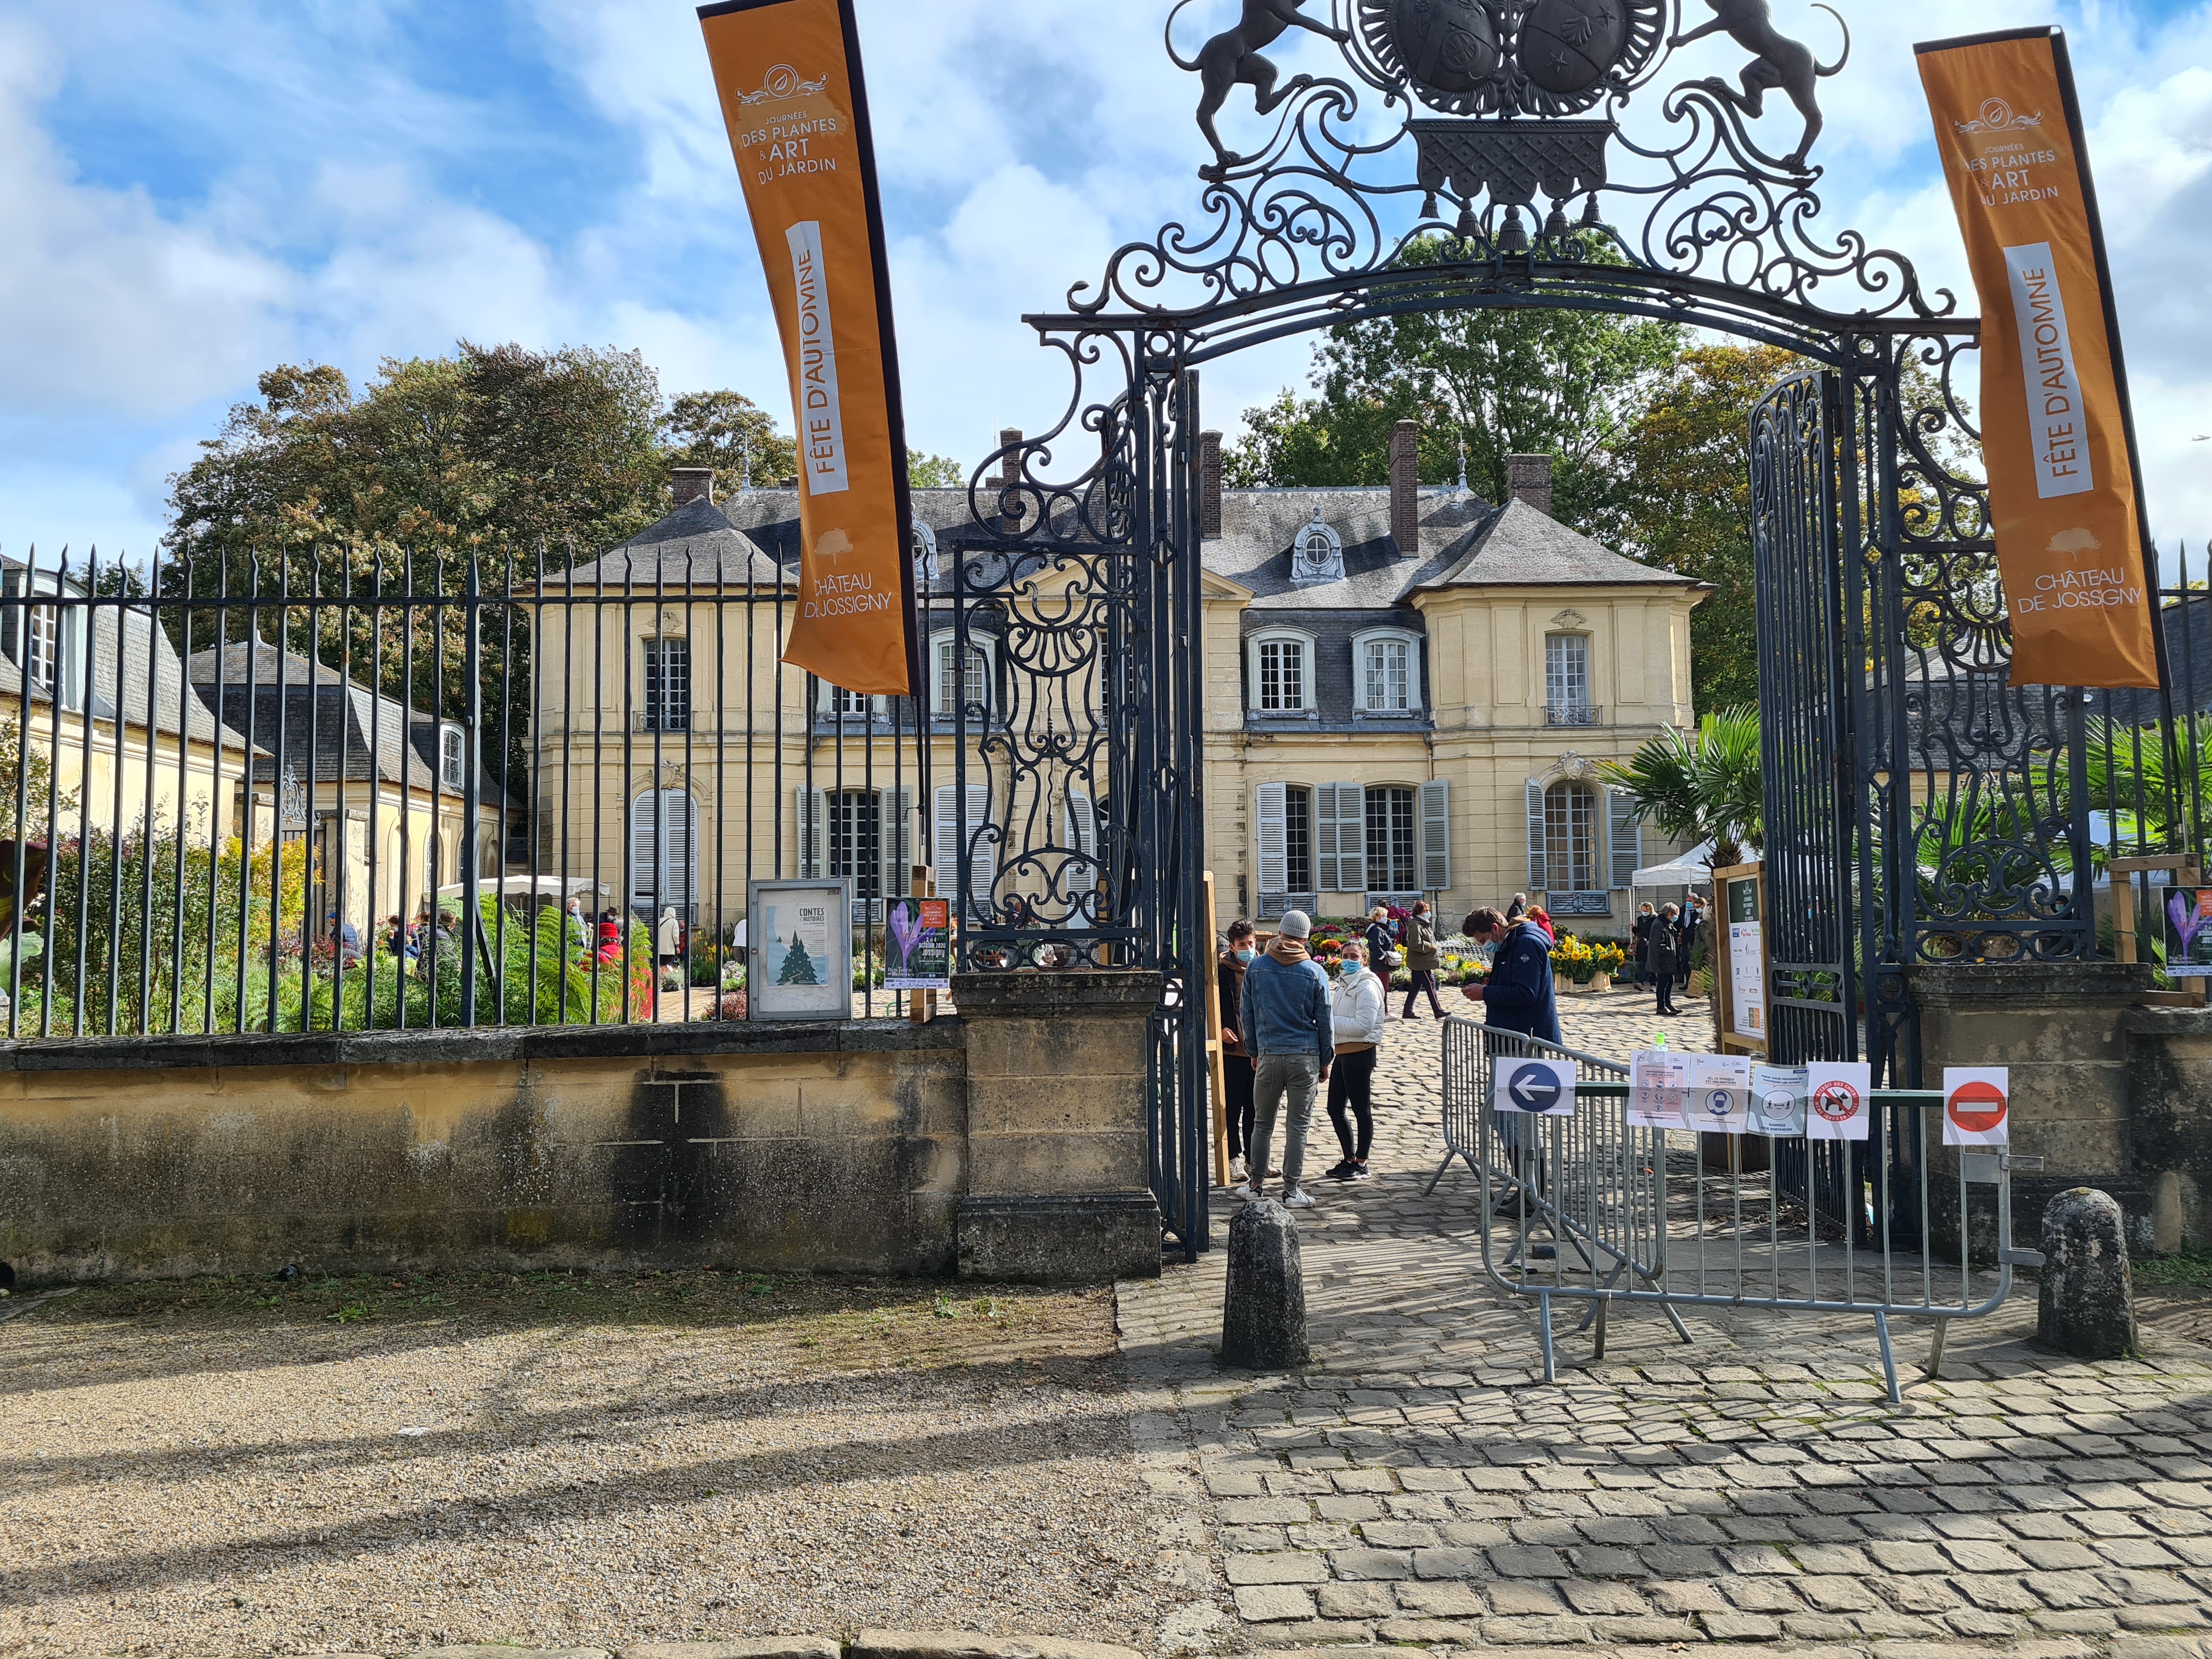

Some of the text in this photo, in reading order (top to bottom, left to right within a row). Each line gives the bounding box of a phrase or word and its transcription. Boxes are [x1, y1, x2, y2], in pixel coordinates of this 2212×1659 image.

[765, 111, 807, 125] JOURNÉES
[741, 118, 837, 148] DES PLANTES
[759, 138, 809, 162] & ART
[1984, 142, 2024, 154] JOURNÉES
[758, 157, 836, 185] DU JARDIN
[1964, 149, 2056, 172] ES PLANTES
[1980, 169, 2029, 190] & ART
[2002, 185, 2059, 205] JARDIN
[799, 249, 835, 475] FÊTE D'AUTOMNE
[2022, 268, 2078, 478] FÊTE D'AUTOMNE
[2035, 567, 2124, 591] CHÂTEAU
[820, 591, 892, 617] JOSSIGNY
[2018, 587, 2142, 613] DE JOSSGNY
[799, 907, 824, 916] CONTES
[1815, 1082, 1832, 1098] INTERDIT
[1844, 1084, 1858, 1098] CHIENS
[1847, 1103, 1858, 1117] LAISSE
